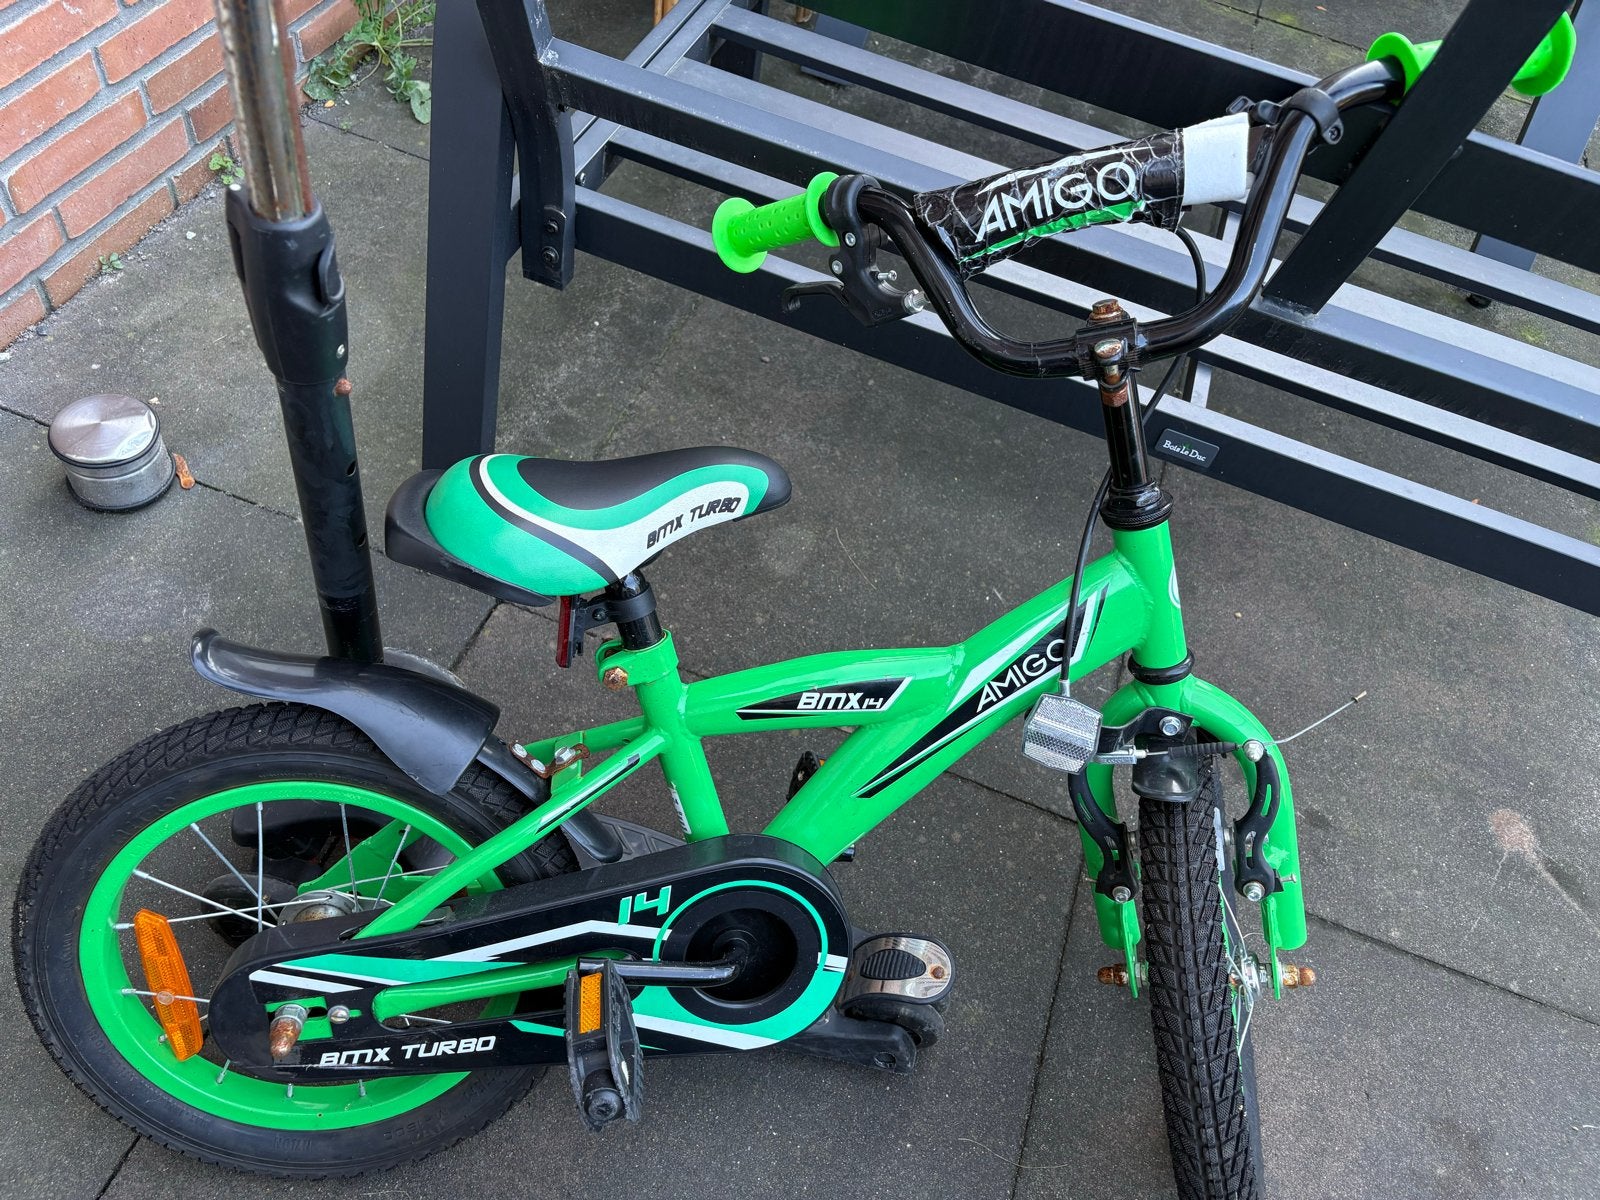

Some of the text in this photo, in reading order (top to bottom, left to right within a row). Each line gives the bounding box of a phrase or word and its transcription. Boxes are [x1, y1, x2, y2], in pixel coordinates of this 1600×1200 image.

[975, 161, 1137, 243] AMIGO
[1163, 440, 1181, 452] Bois
[1189, 449, 1207, 461] Duc
[646, 497, 742, 550] BMX TURBO
[976, 638, 1066, 713] AMIGO
[617, 884, 672, 926] 14
[319, 1035, 497, 1067] BMX TURBO
